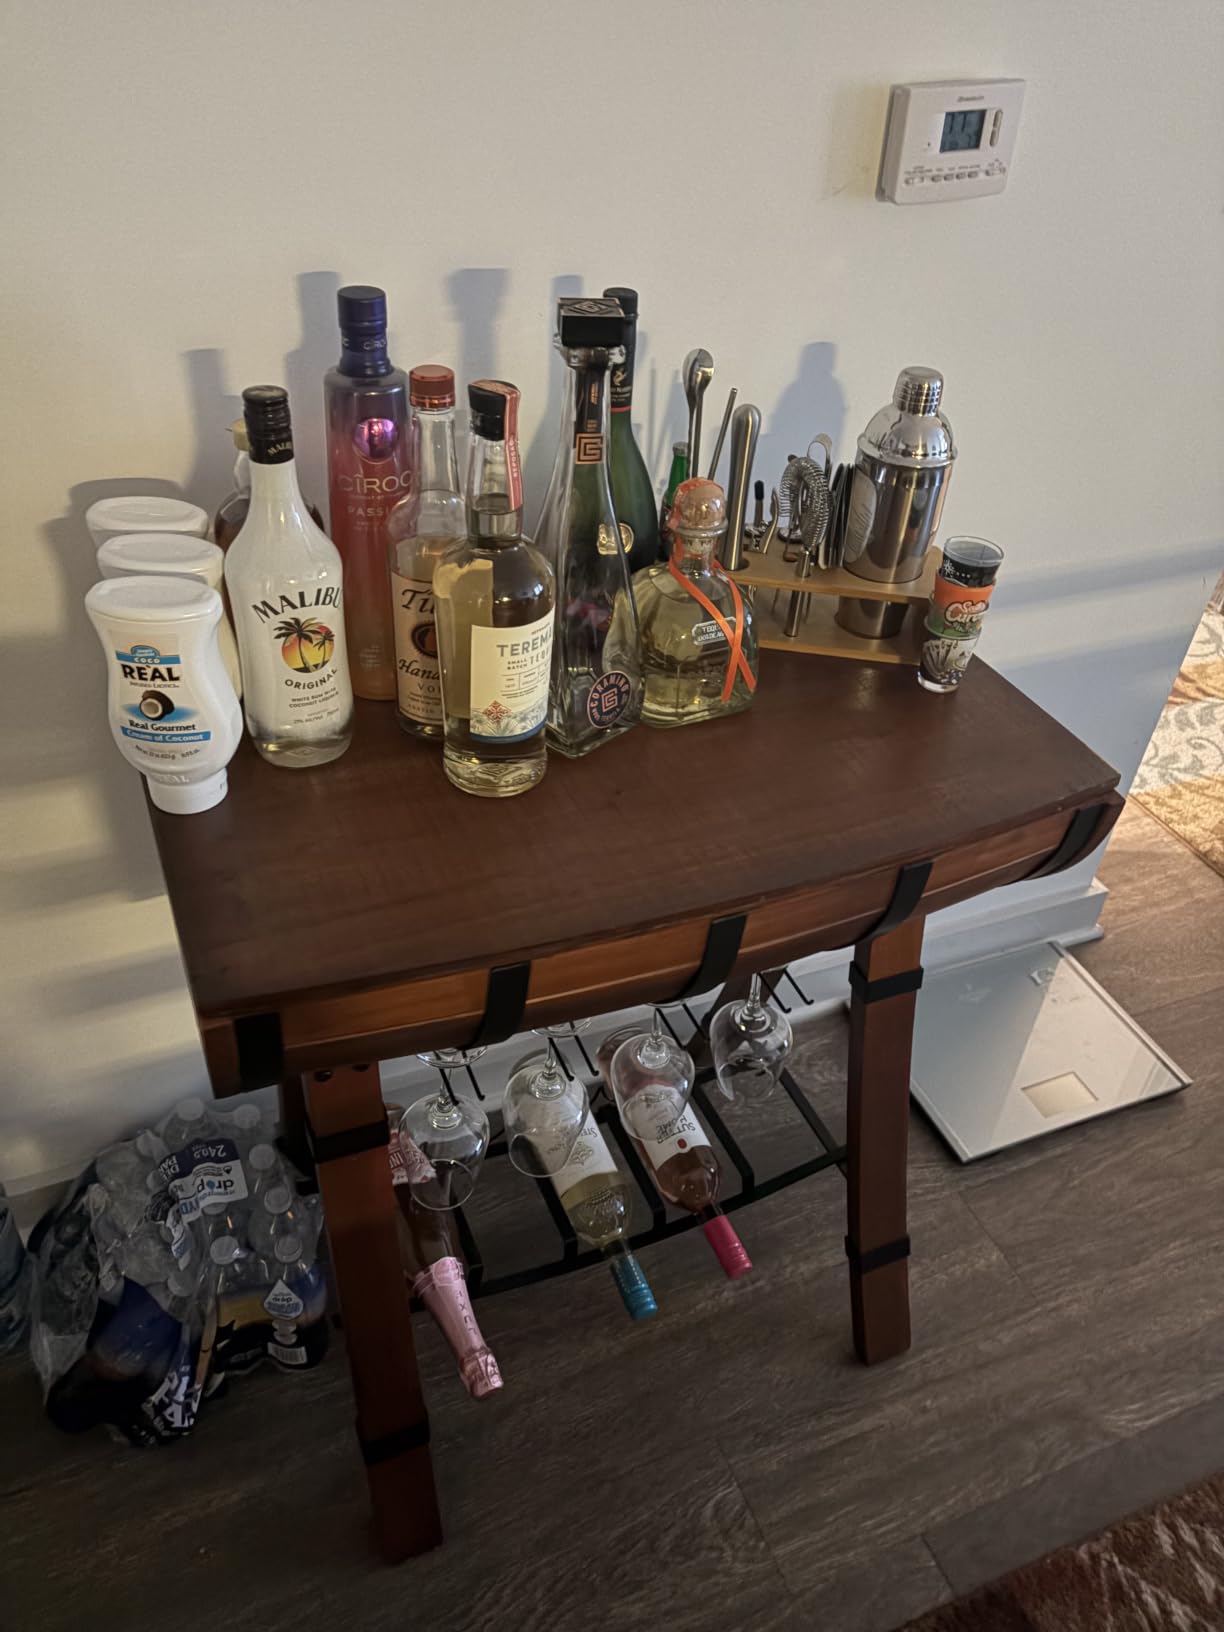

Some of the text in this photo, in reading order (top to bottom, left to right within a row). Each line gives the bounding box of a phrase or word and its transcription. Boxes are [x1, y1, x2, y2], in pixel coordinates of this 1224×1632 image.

[252, 587, 341, 624] MALIBU
[285, 668, 338, 690] ORIGINAL
[128, 719, 196, 732] Real Gourmet
